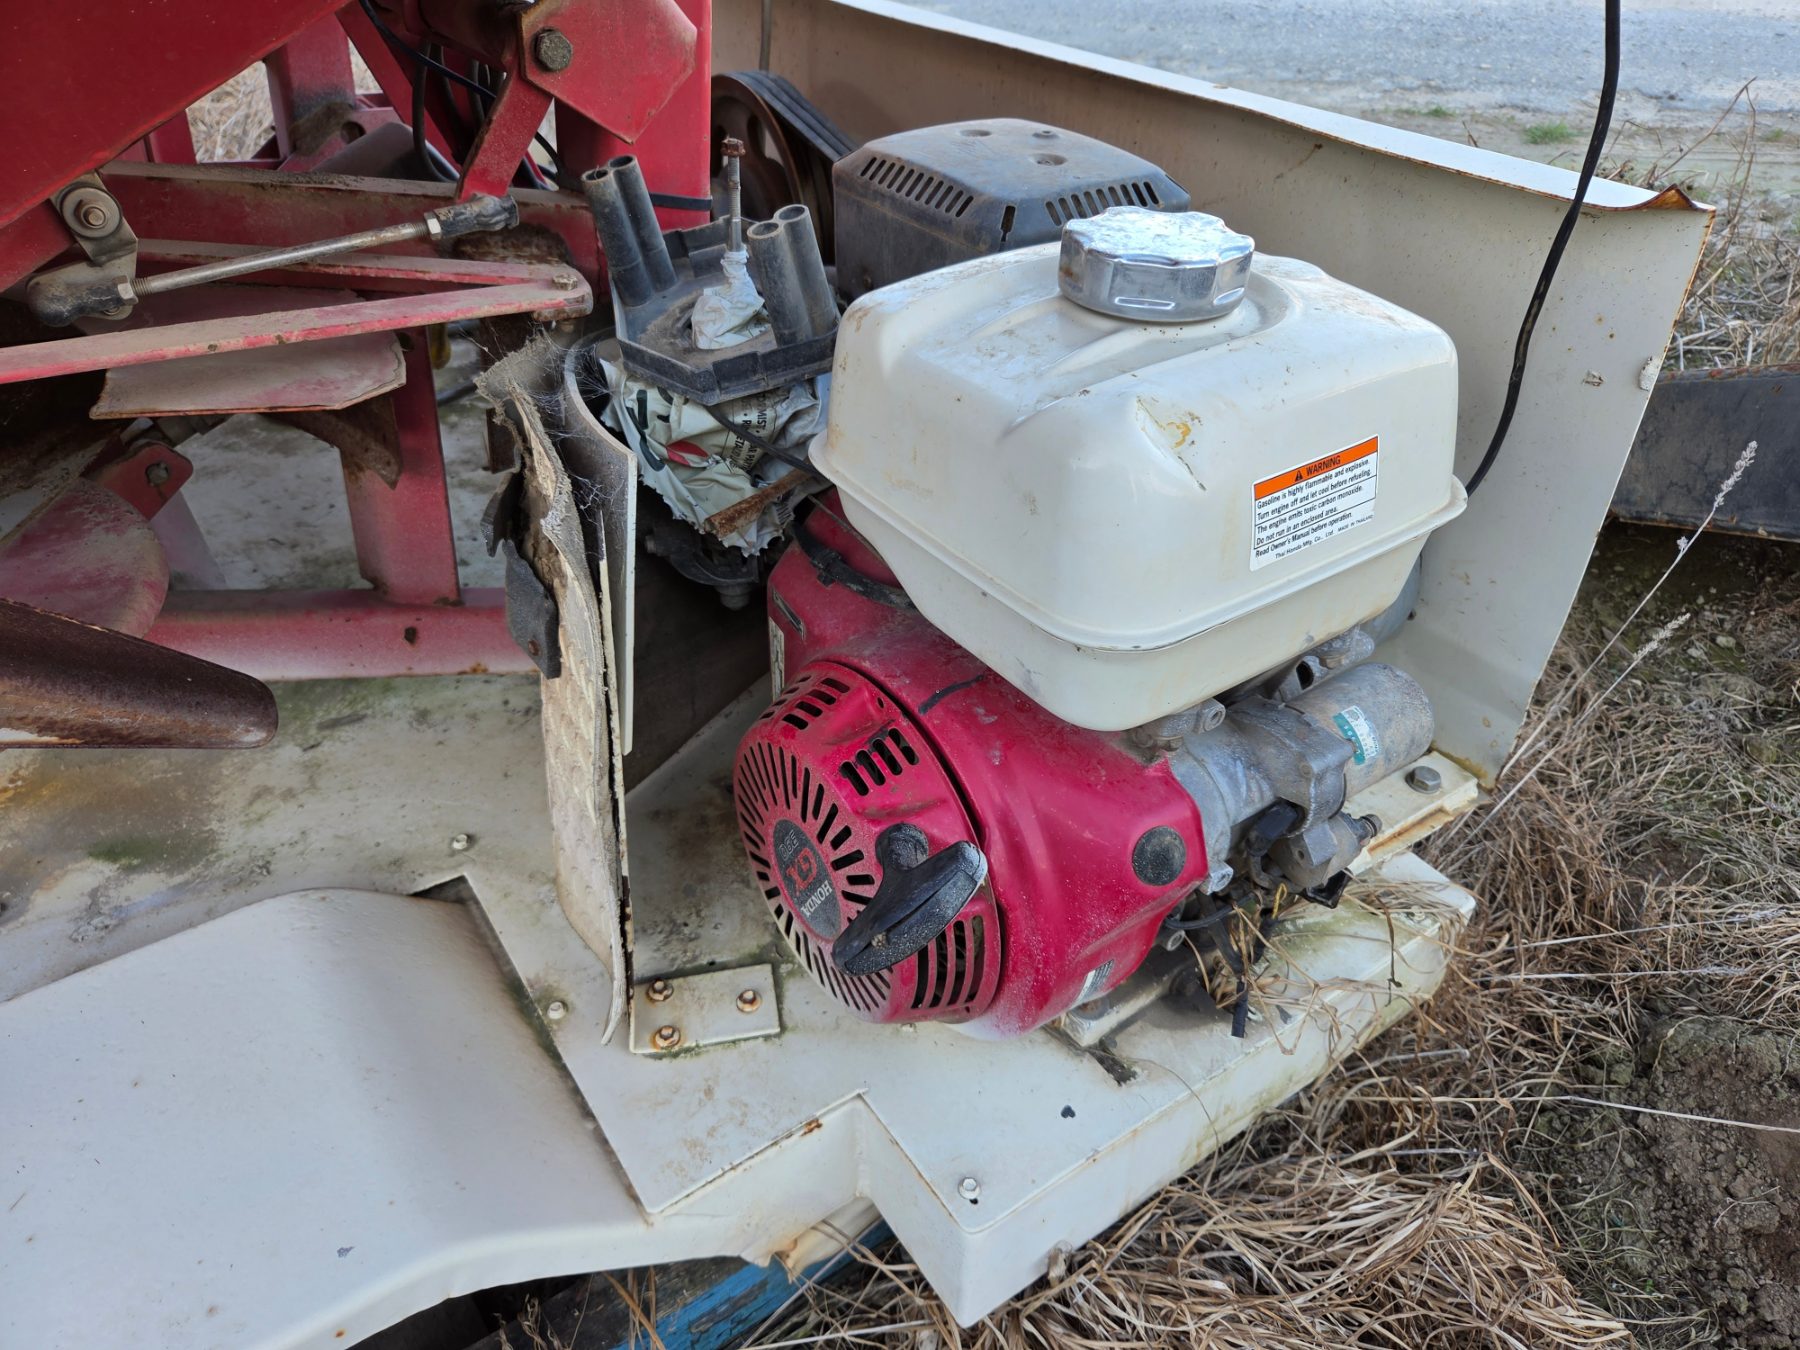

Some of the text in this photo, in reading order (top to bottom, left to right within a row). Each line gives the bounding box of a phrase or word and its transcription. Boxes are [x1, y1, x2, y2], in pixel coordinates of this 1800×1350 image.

[1306, 455, 1341, 477] WARNING
[1257, 496, 1280, 510] Gasoline
[1288, 485, 1304, 497] highly
[1305, 473, 1333, 490] flammable
[1334, 468, 1344, 478] and
[1257, 511, 1270, 521] Turn
[1271, 504, 1289, 516] engine
[1291, 497, 1299, 507] off
[1300, 493, 1310, 503] and
[1310, 490, 1318, 499] let
[1318, 485, 1329, 495] cool
[1331, 479, 1347, 490] before
[1256, 506, 1337, 546] Do not run in an enclosed area.
[1257, 525, 1267, 534] The
[1269, 517, 1287, 530] engine
[1288, 510, 1303, 521] emits
[1304, 503, 1317, 514] toxic
[1318, 496, 1336, 508] carbon
[1256, 546, 1270, 558] Read
[1271, 538, 1291, 551] Owner's
[1292, 530, 1310, 542] Manual
[1311, 522, 1327, 534] before
[1287, 545, 1303, 554] Honda
[786, 847, 817, 897] GX
[801, 880, 833, 917] HONDA
